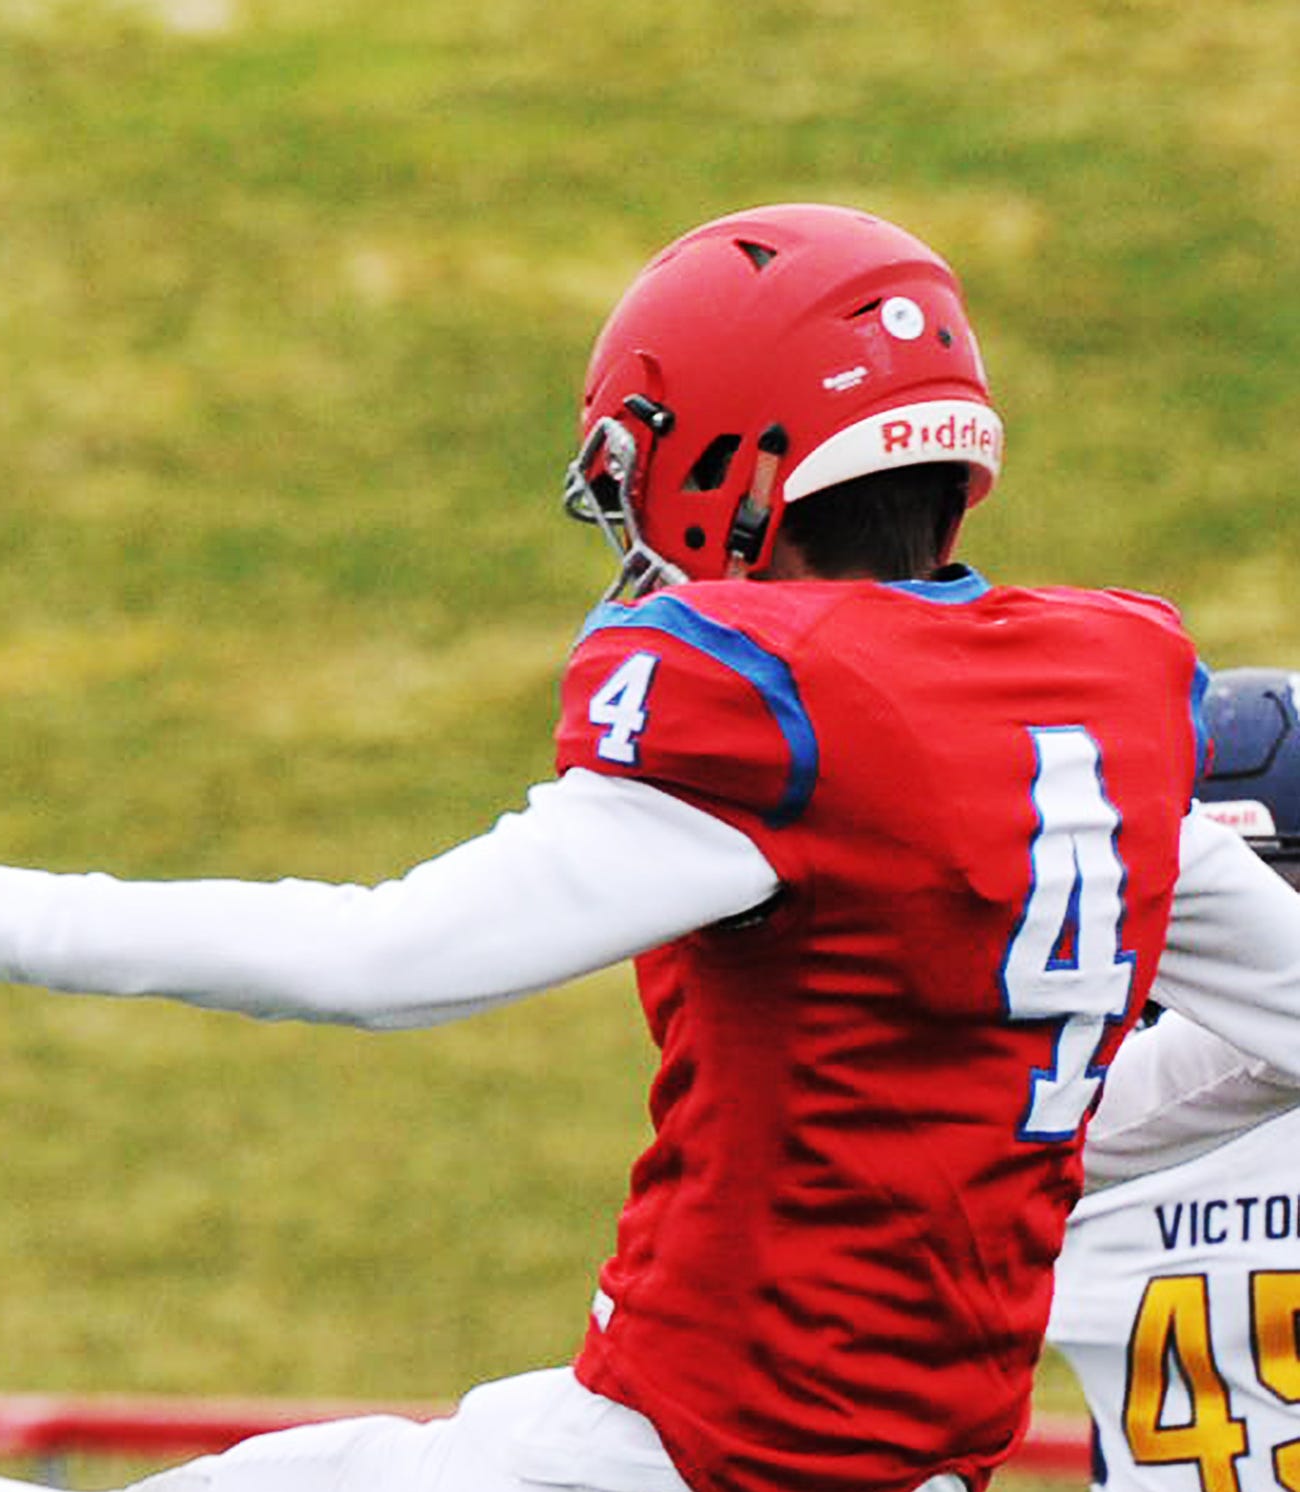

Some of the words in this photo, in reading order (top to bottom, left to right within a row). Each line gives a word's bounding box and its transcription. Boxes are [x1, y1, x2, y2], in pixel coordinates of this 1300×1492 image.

[881, 412, 1000, 456] Ridde
[588, 650, 660, 767] 4
[1000, 725, 1137, 1143] 4
[1155, 1194, 1300, 1250] VICTO
